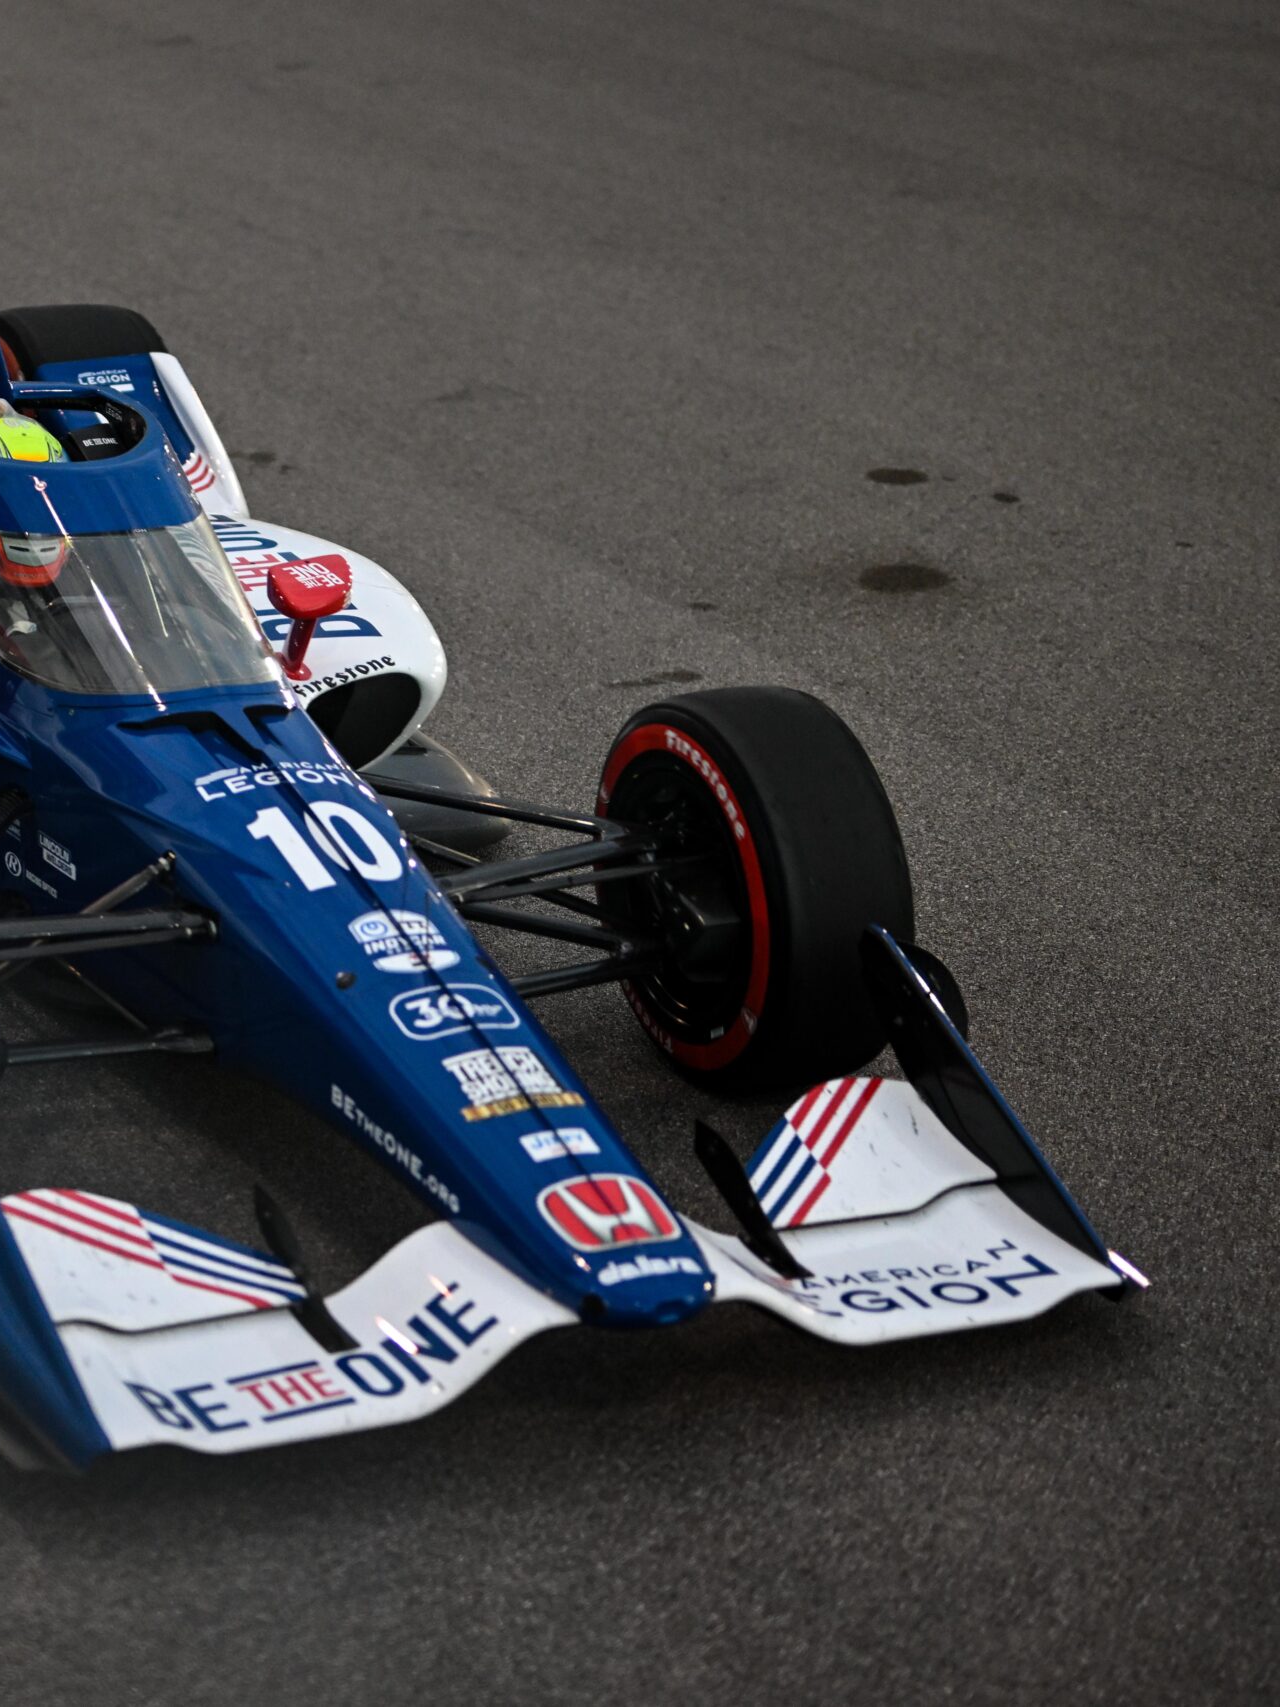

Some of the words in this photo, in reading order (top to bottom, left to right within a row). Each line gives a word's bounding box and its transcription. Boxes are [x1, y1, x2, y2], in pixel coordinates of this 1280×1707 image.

[78, 373, 131, 386] LEGION
[317, 572, 345, 588] BE
[293, 654, 397, 698] Firestone
[196, 770, 354, 802] LEGION
[240, 760, 340, 774] AMRICAN
[664, 728, 746, 841] Firestone
[246, 801, 404, 892] 10
[330, 1084, 461, 1214] BETHEONE.ORG
[799, 1238, 1019, 1291] AMERICAN
[123, 1382, 248, 1435] BE
[236, 1368, 346, 1411] THE
[337, 1282, 499, 1397] ONE
